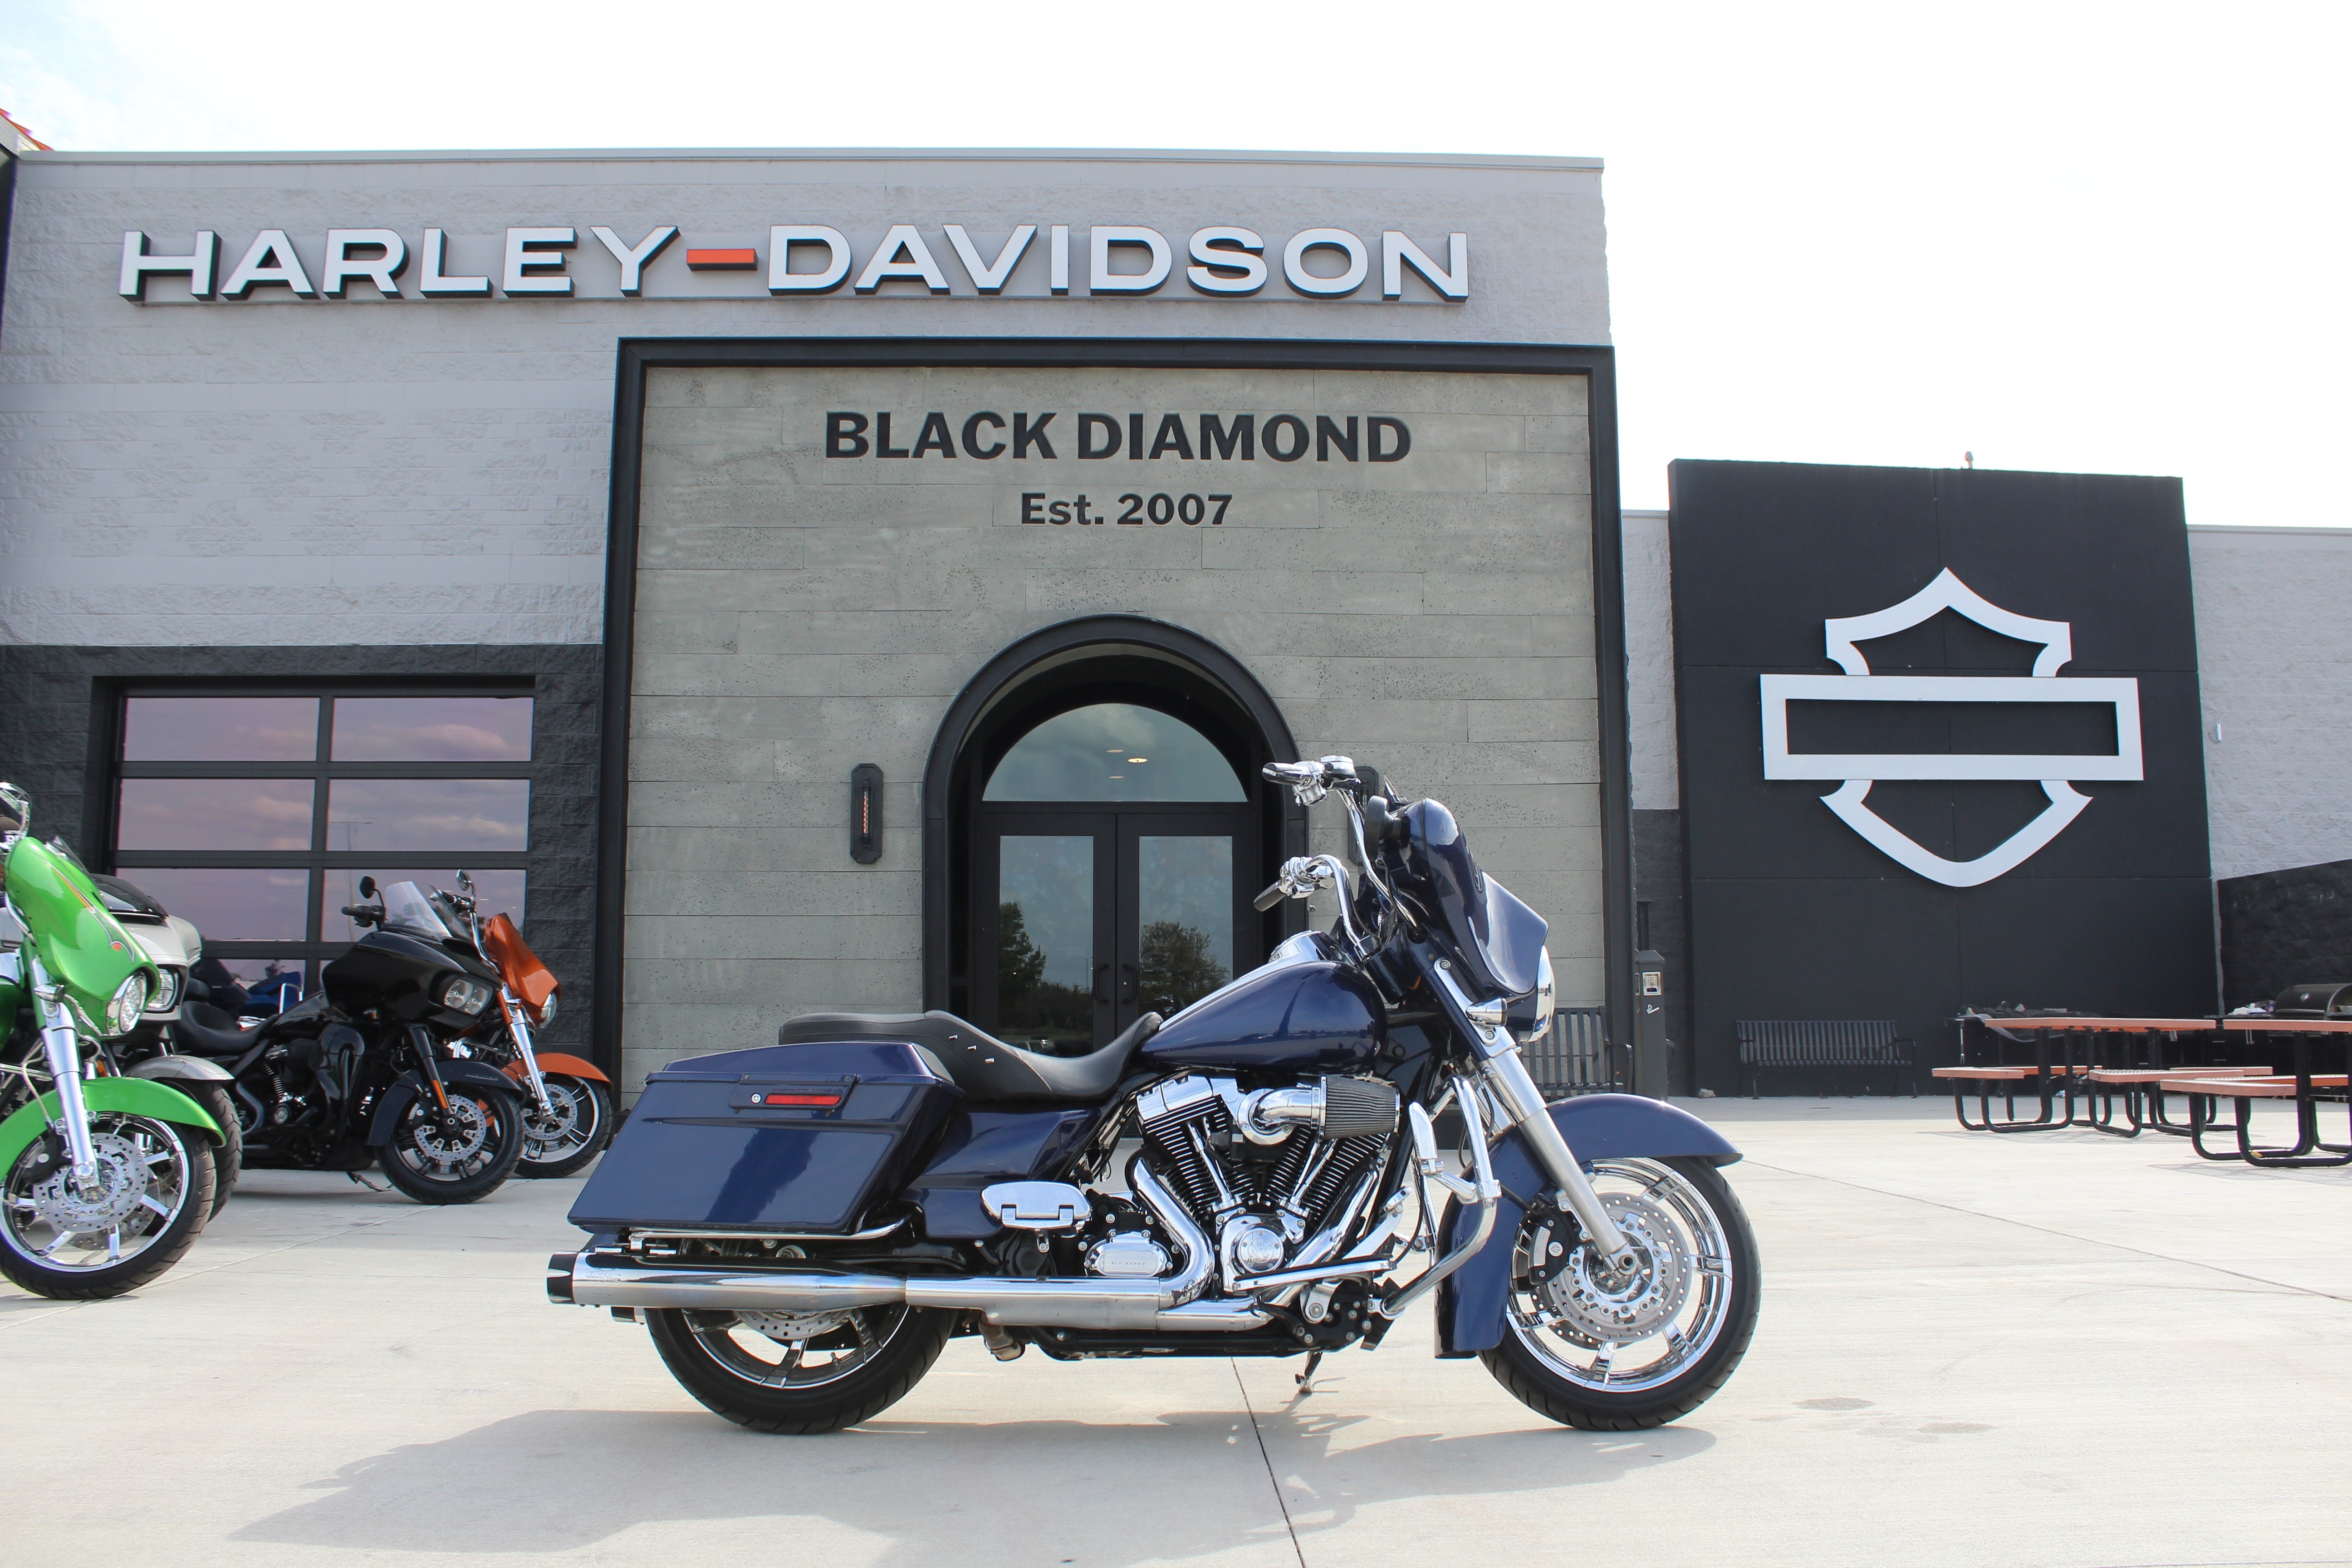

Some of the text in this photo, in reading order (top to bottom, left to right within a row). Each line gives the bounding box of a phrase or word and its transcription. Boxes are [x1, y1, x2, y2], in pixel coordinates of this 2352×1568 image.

[118, 225, 1469, 304] HARLEY-DAVIDSON
[826, 411, 1411, 462] BLACK DIAMOND
[1021, 492, 1233, 526] Est. 2007
